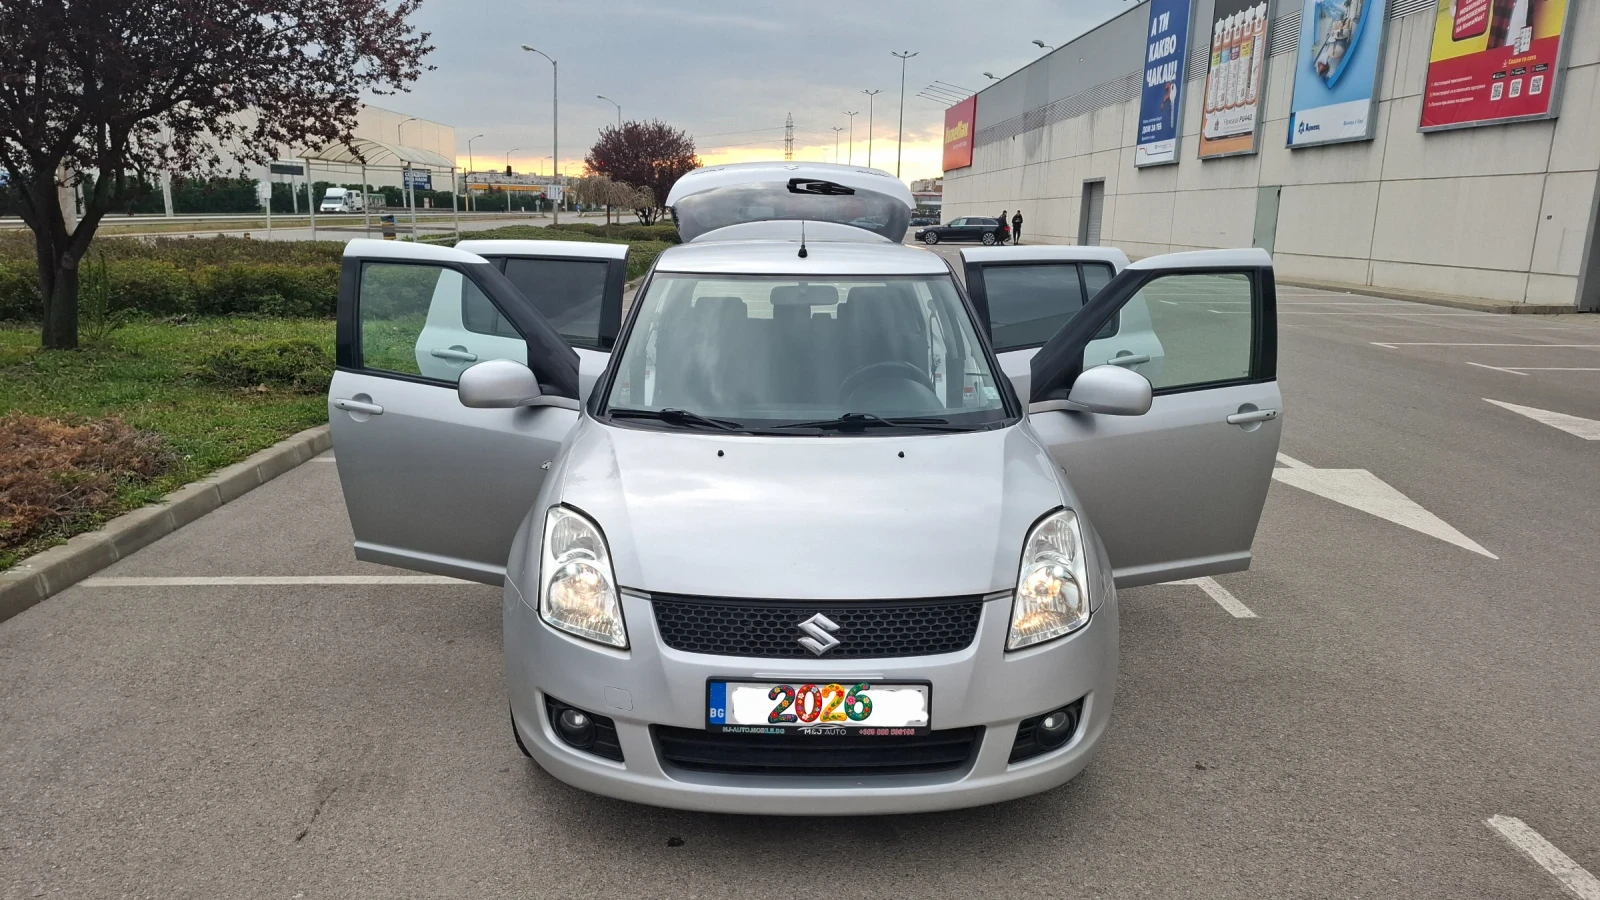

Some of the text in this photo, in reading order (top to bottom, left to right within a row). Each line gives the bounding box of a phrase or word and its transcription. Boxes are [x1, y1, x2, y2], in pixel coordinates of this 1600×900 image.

[1151, 11, 1170, 37] А ТИ
[1148, 34, 1177, 62] КАКВО
[709, 708, 725, 718] BG
[824, 728, 847, 736] AUTO
